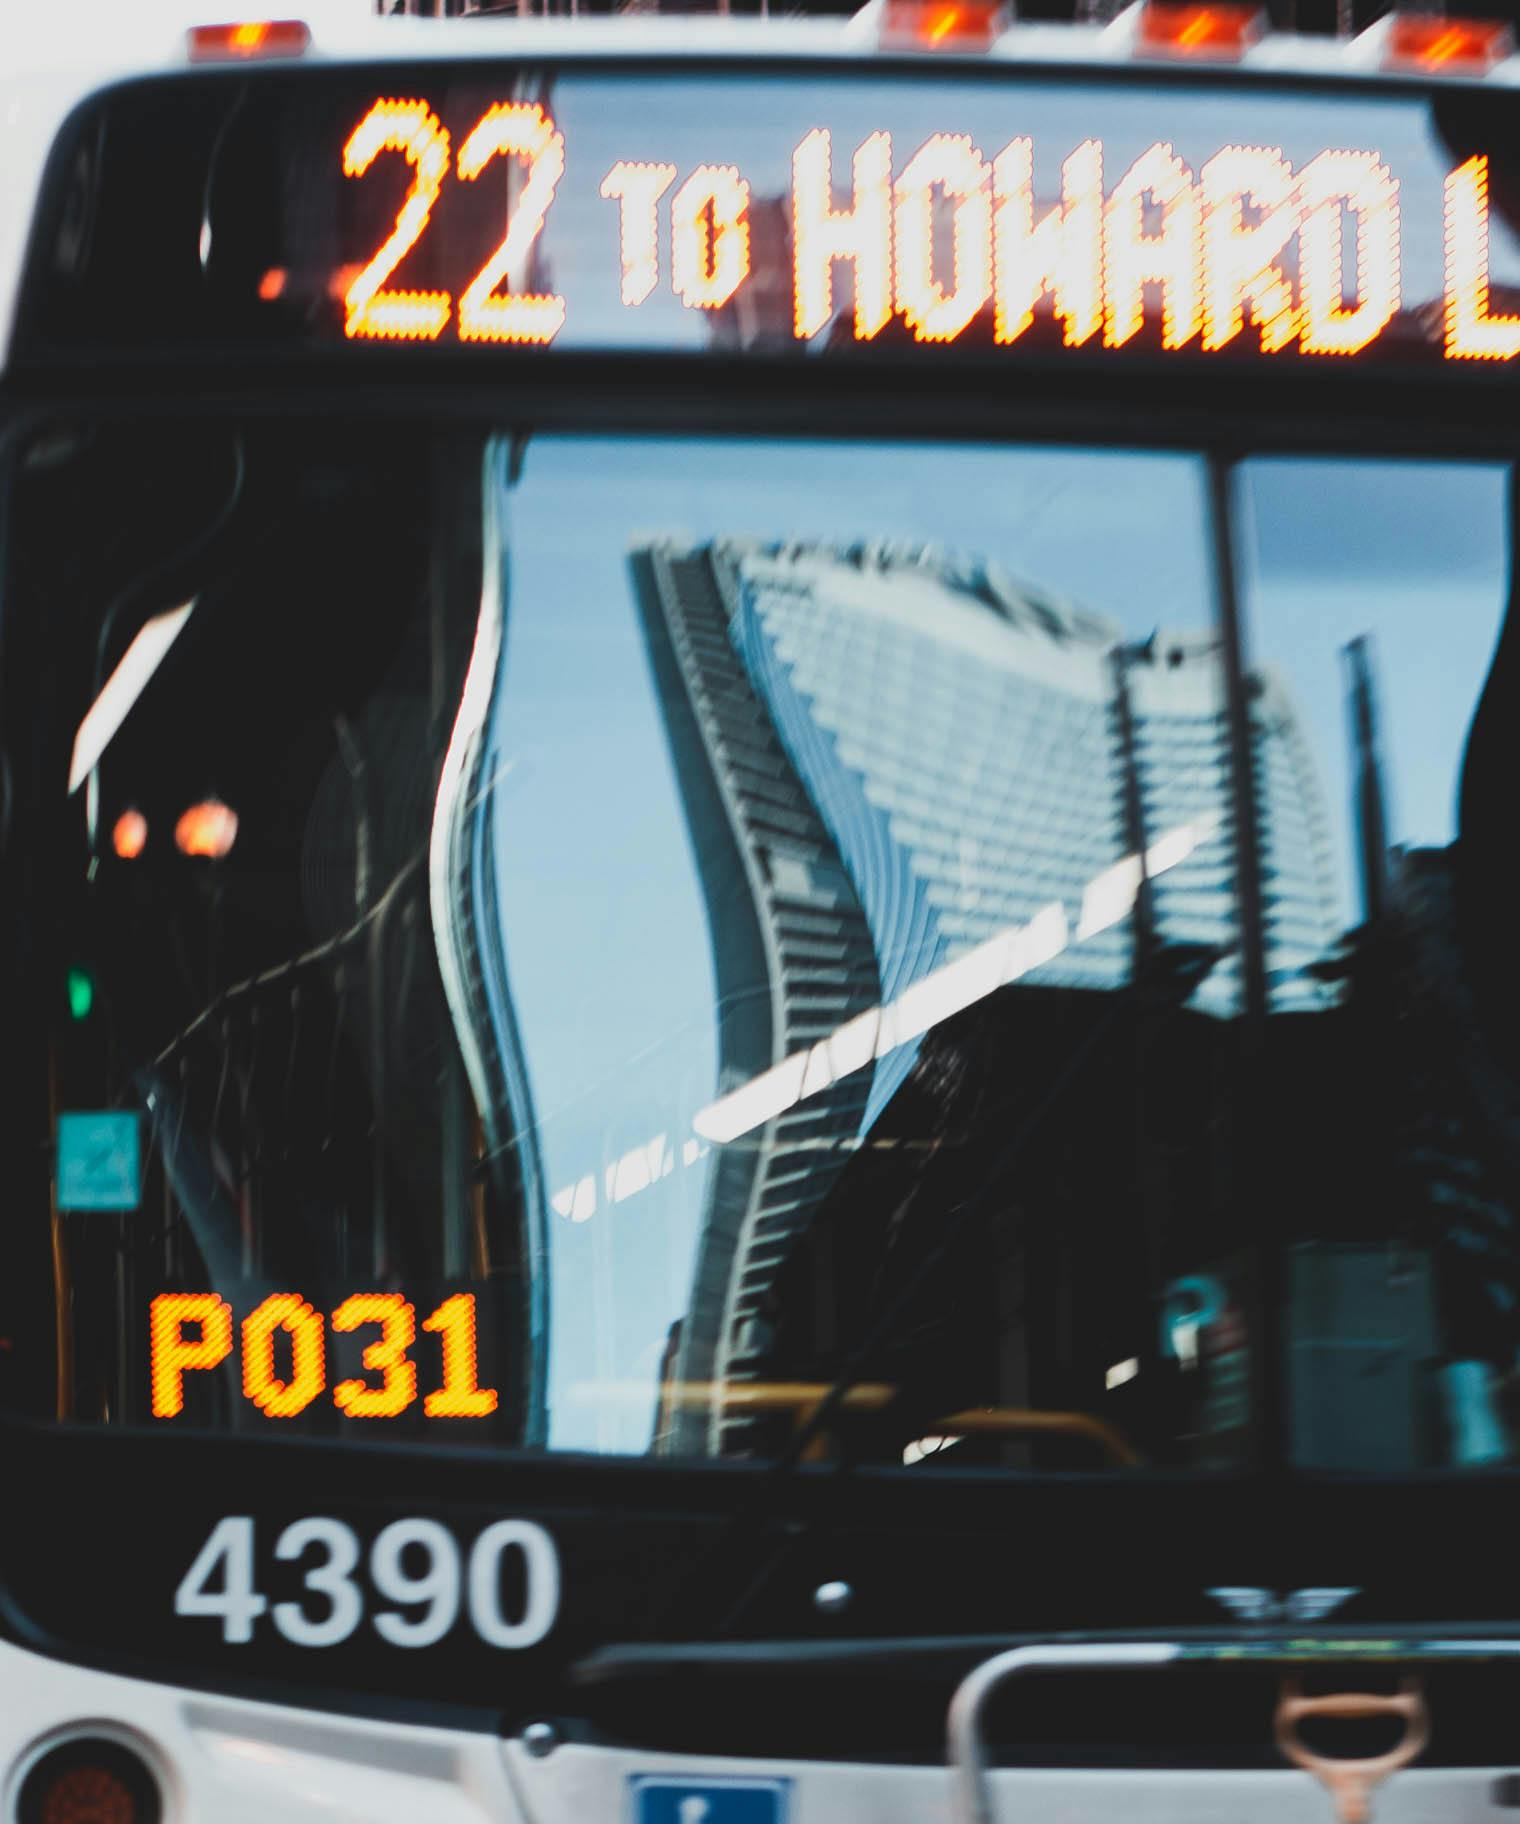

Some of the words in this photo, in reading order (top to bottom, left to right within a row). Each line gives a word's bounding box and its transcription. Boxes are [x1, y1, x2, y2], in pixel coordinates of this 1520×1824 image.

[343, 98, 566, 343] 22
[601, 161, 751, 309] TO
[790, 126, 1402, 356] HOWARD
[150, 1293, 498, 1418] P031
[175, 1516, 560, 1650] 4390
